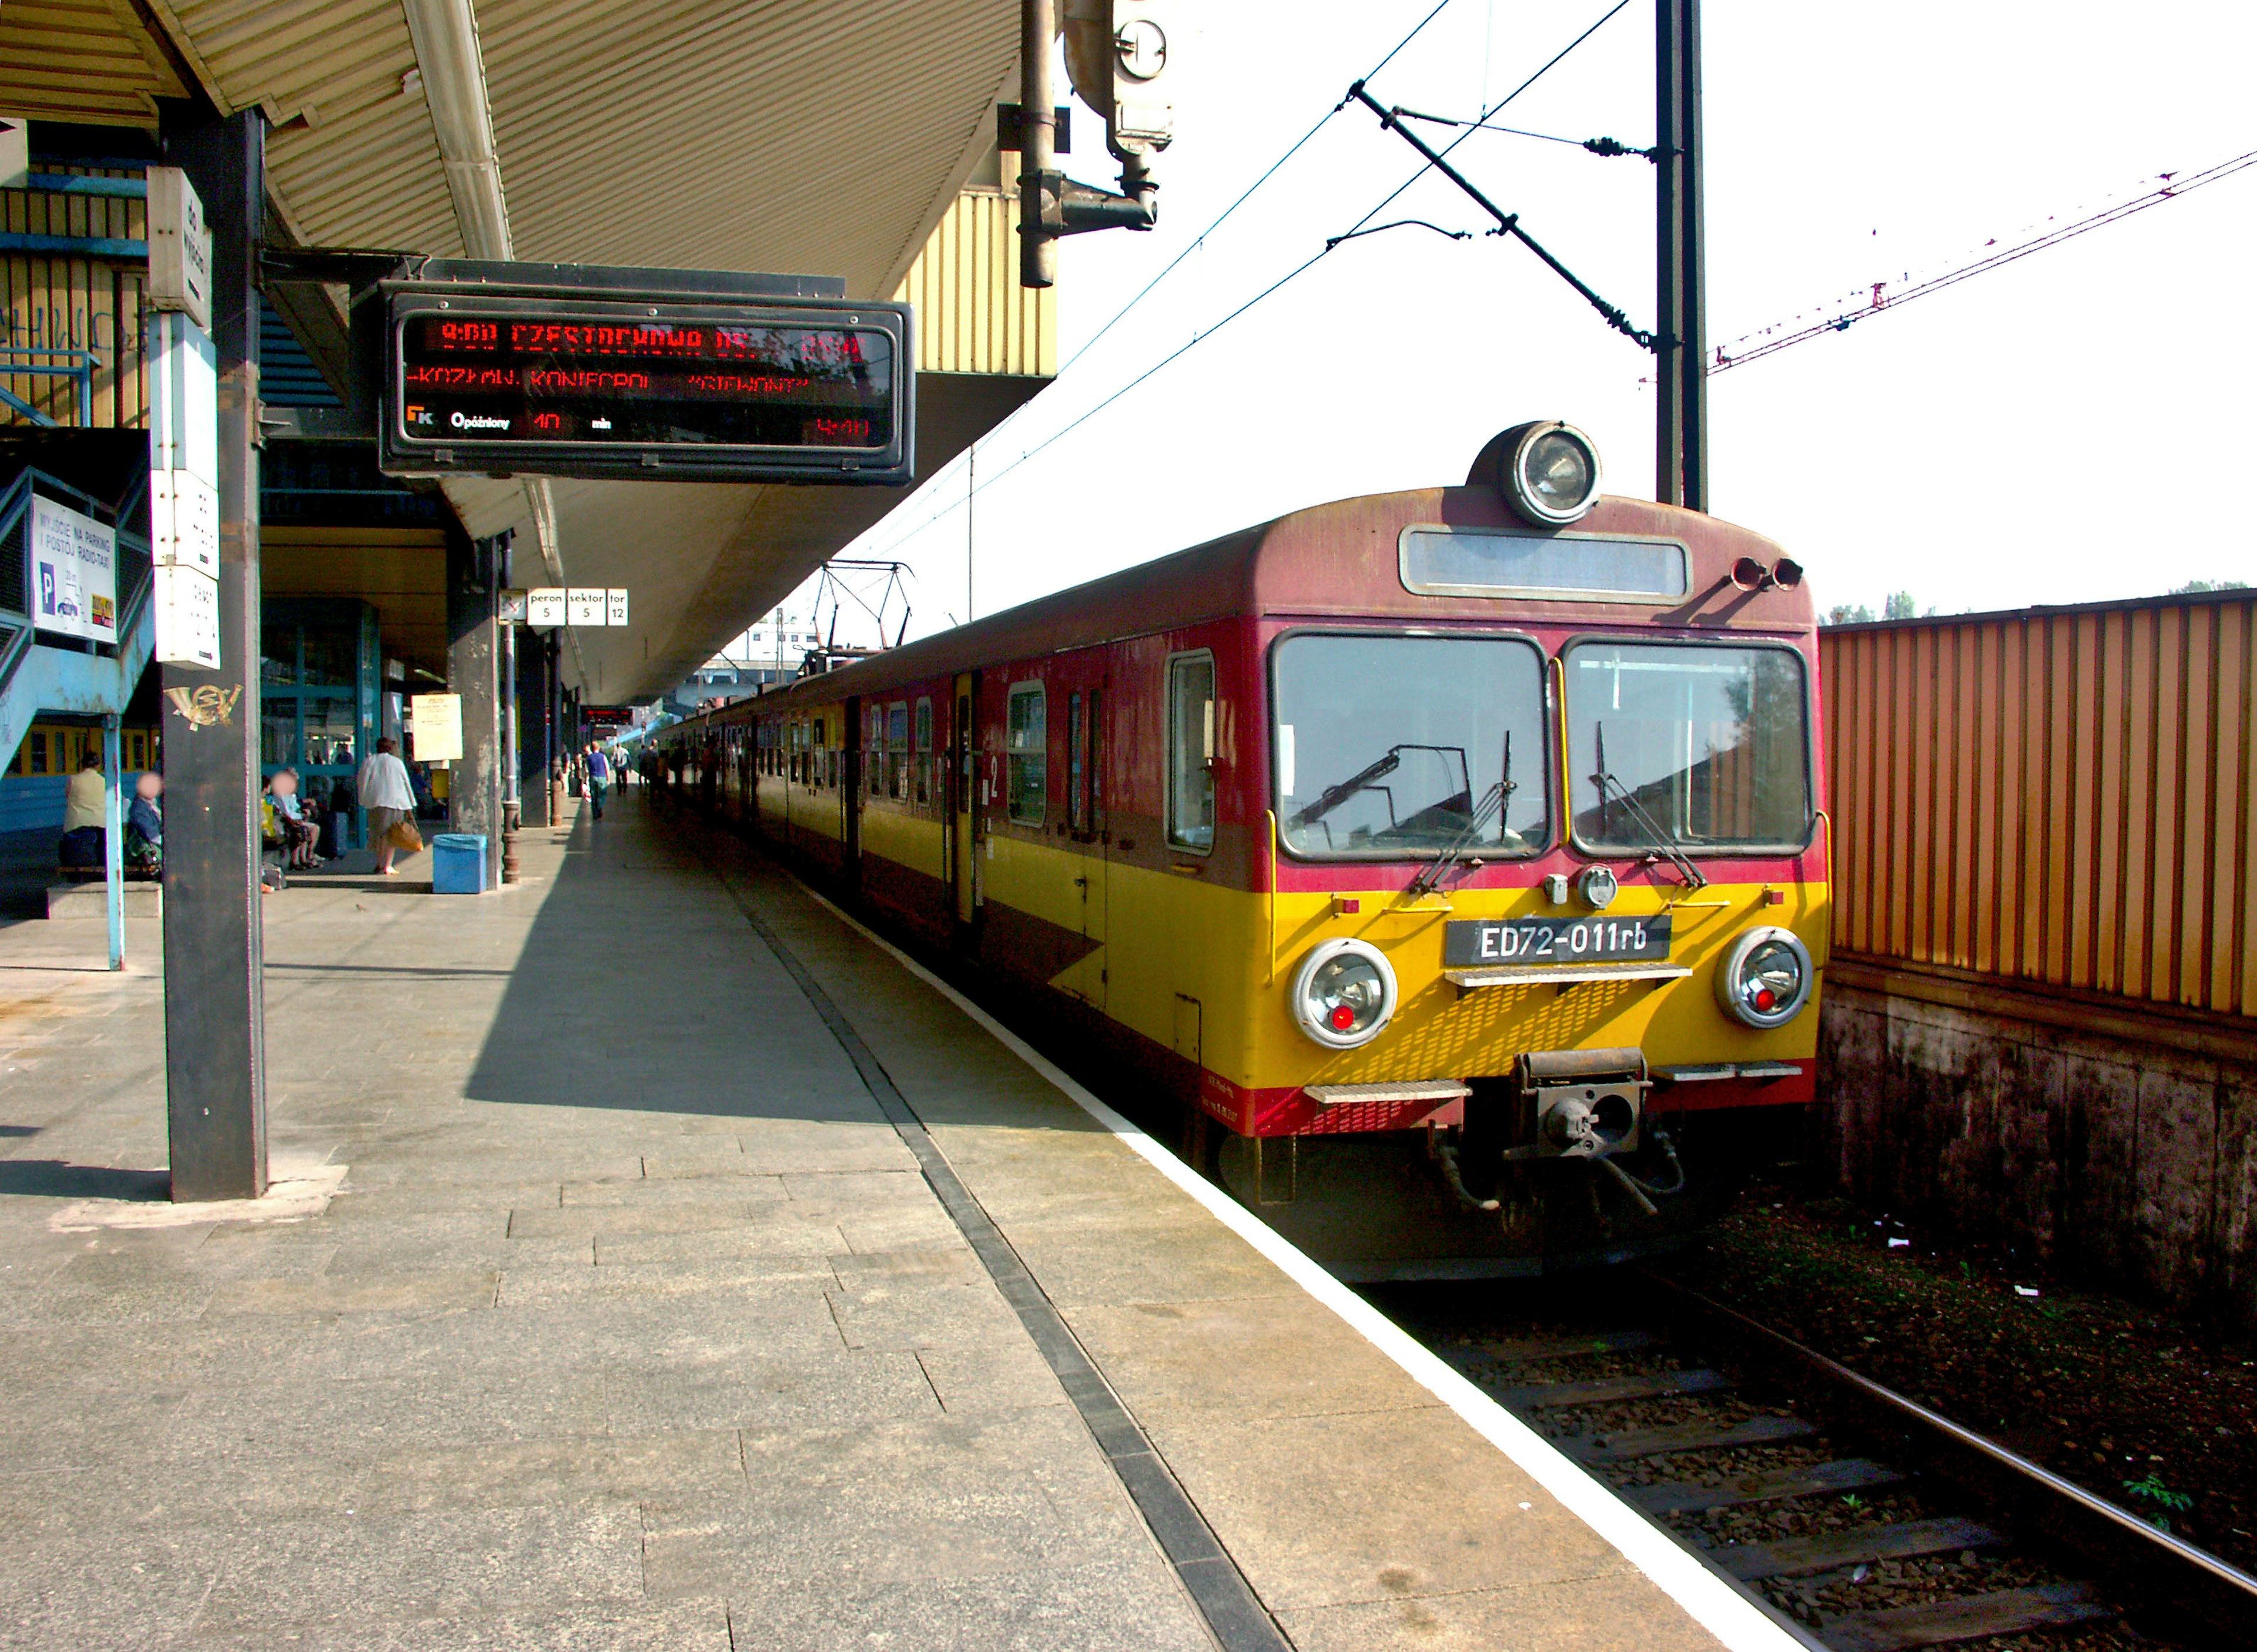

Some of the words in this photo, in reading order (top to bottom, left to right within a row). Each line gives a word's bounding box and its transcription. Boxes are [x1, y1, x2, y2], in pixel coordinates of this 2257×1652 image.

[591, 417, 612, 430] min
[41, 512, 71, 538] WYJŚCIE
[74, 527, 83, 541] NA
[85, 531, 111, 552] PARKING
[46, 534, 75, 557] POSTÓJ
[78, 545, 110, 570] RADIO-TAXI
[43, 572, 53, 604] P
[531, 595, 562, 603] peron
[570, 593, 604, 602] sektor
[610, 594, 625, 602] tor
[543, 608, 550, 618] 5
[583, 608, 590, 618] 5
[612, 608, 624, 618] 12
[990, 755, 998, 798] 2
[1481, 921, 1647, 959] ED72-011rb
